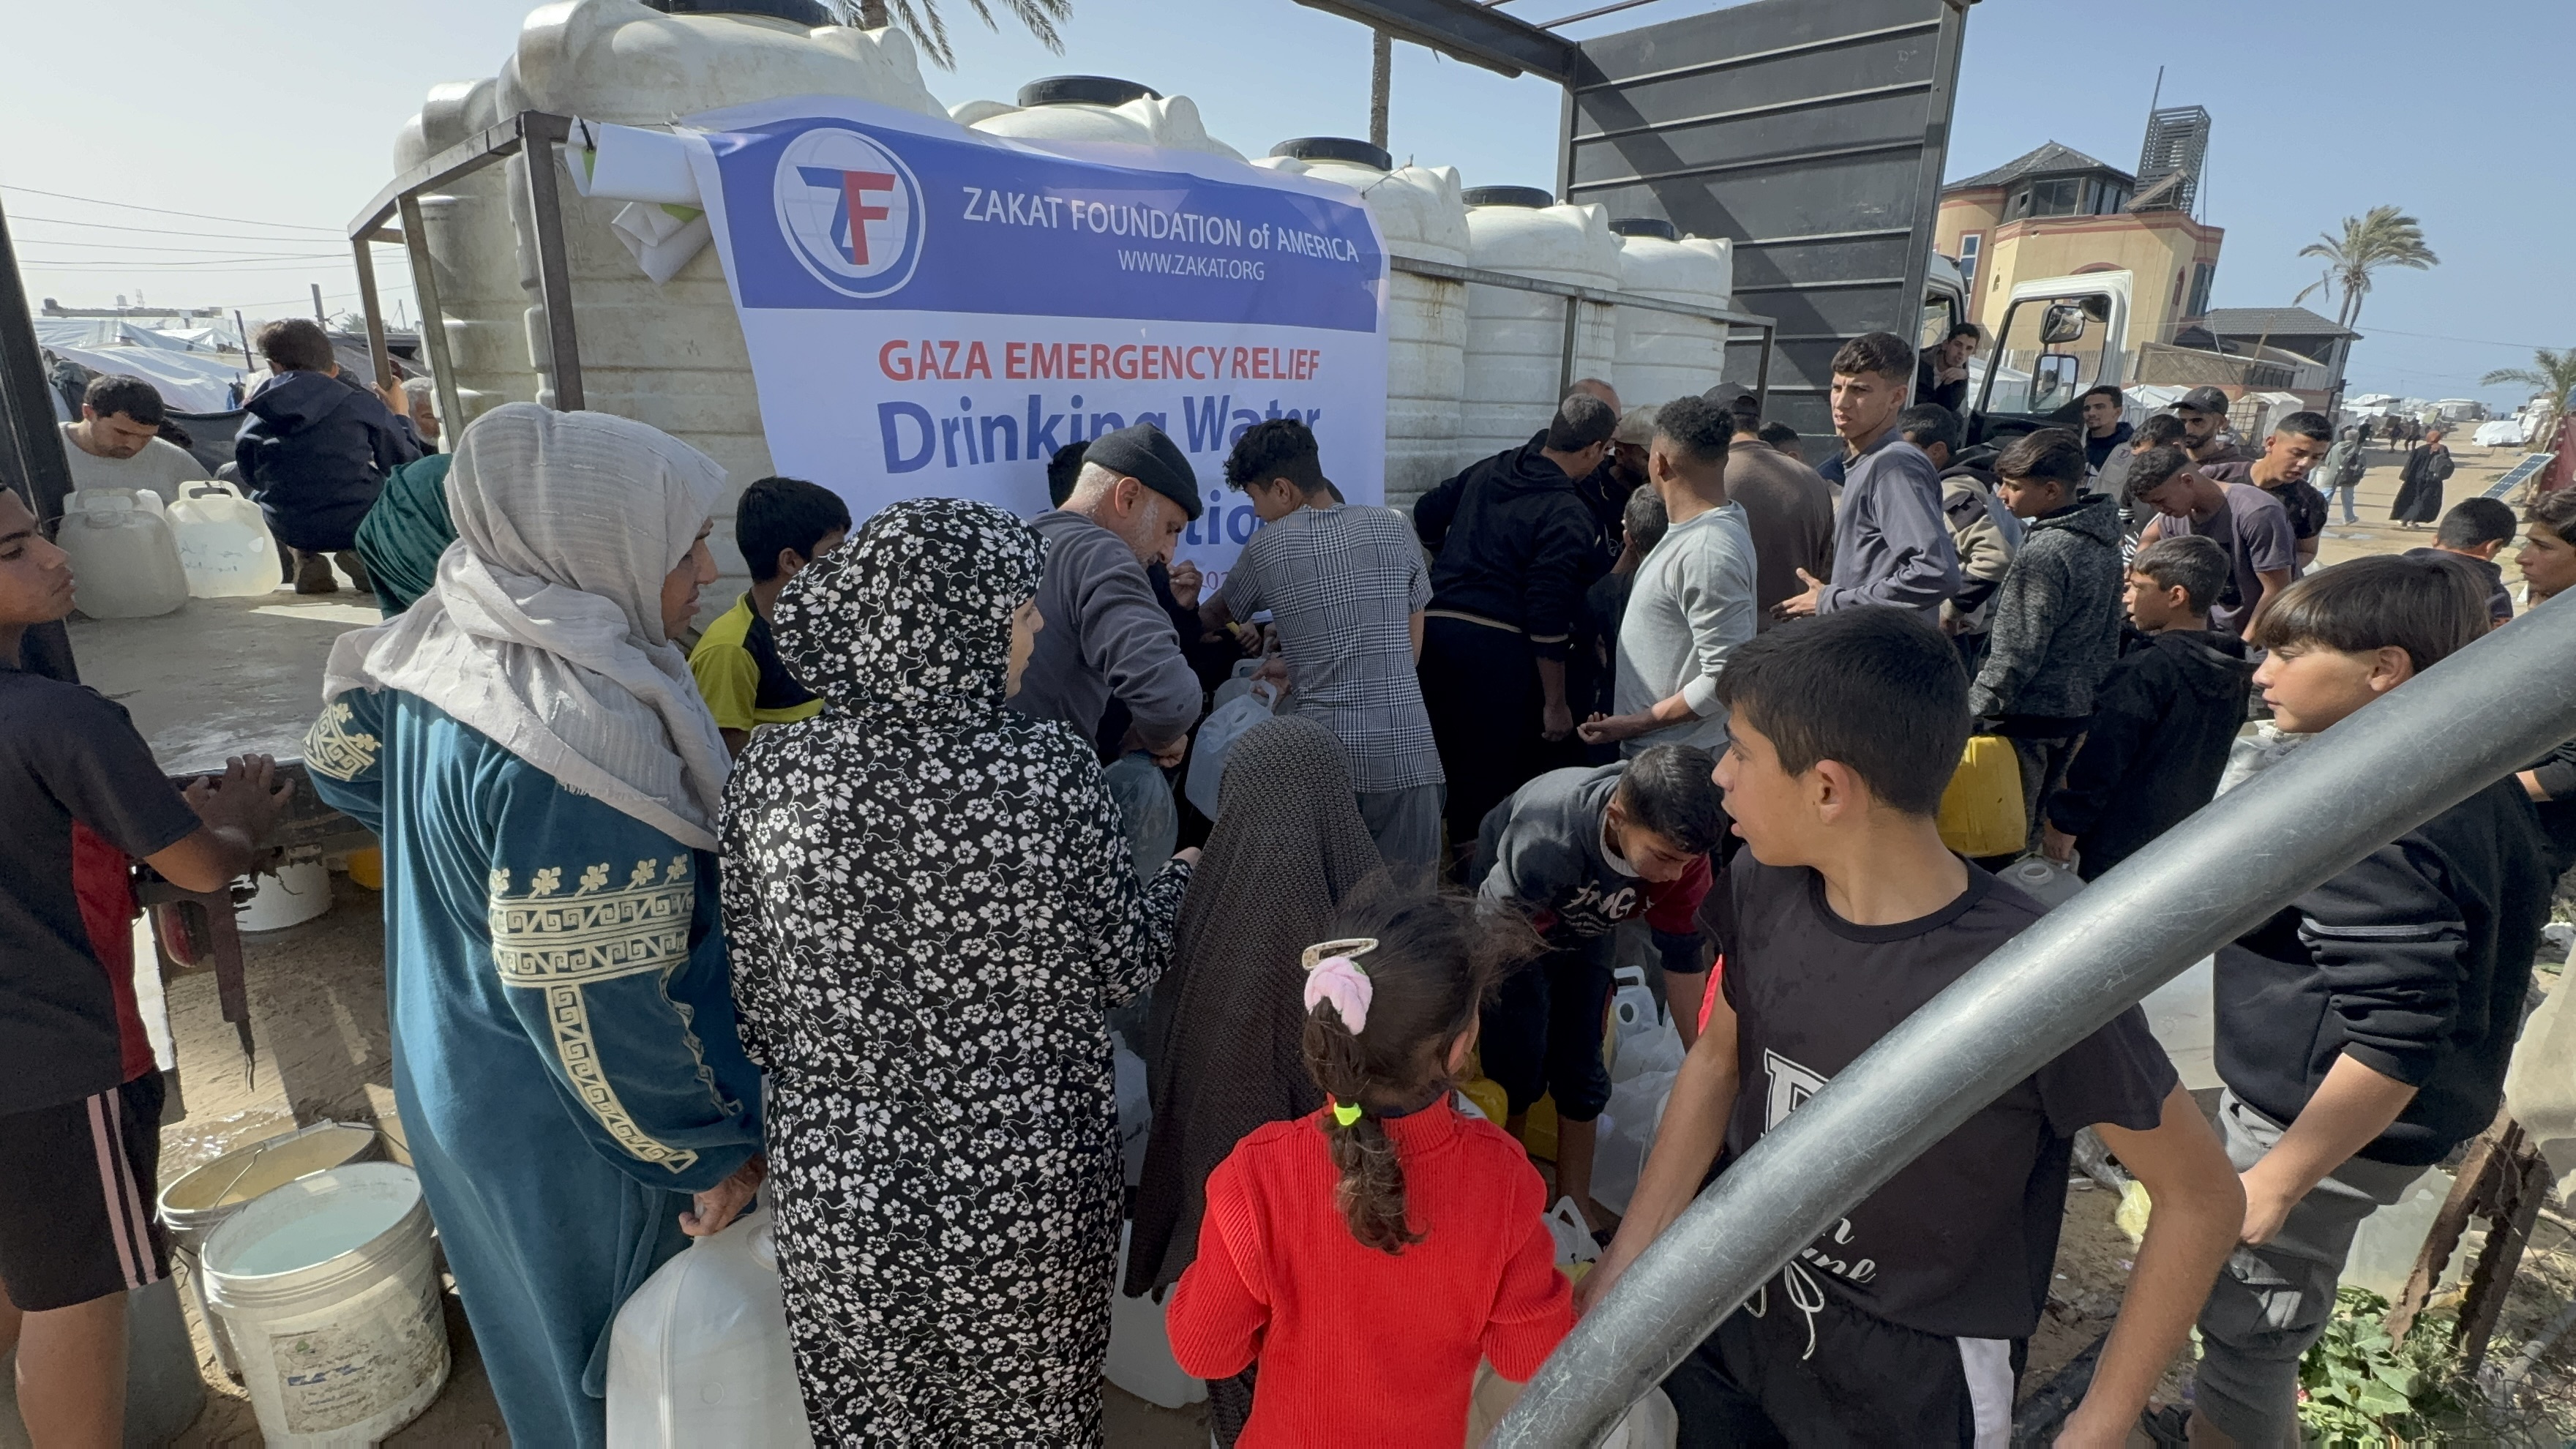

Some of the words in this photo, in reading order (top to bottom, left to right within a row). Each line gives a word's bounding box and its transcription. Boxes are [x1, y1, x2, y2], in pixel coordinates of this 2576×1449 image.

[963, 187, 1063, 228] ZAKAT
[1072, 199, 1241, 247] FOUNDATION
[1249, 223, 1270, 250] of
[1278, 227, 1360, 263] AMERICA
[1118, 250, 1265, 281] WWW.ZAKAT.ORG
[879, 340, 992, 381] GAZA
[1006, 342, 1227, 380] EMERGENCY
[1231, 346, 1320, 380] RELIEF
[877, 394, 1167, 473] Drinkin
[1183, 394, 1320, 453] War
